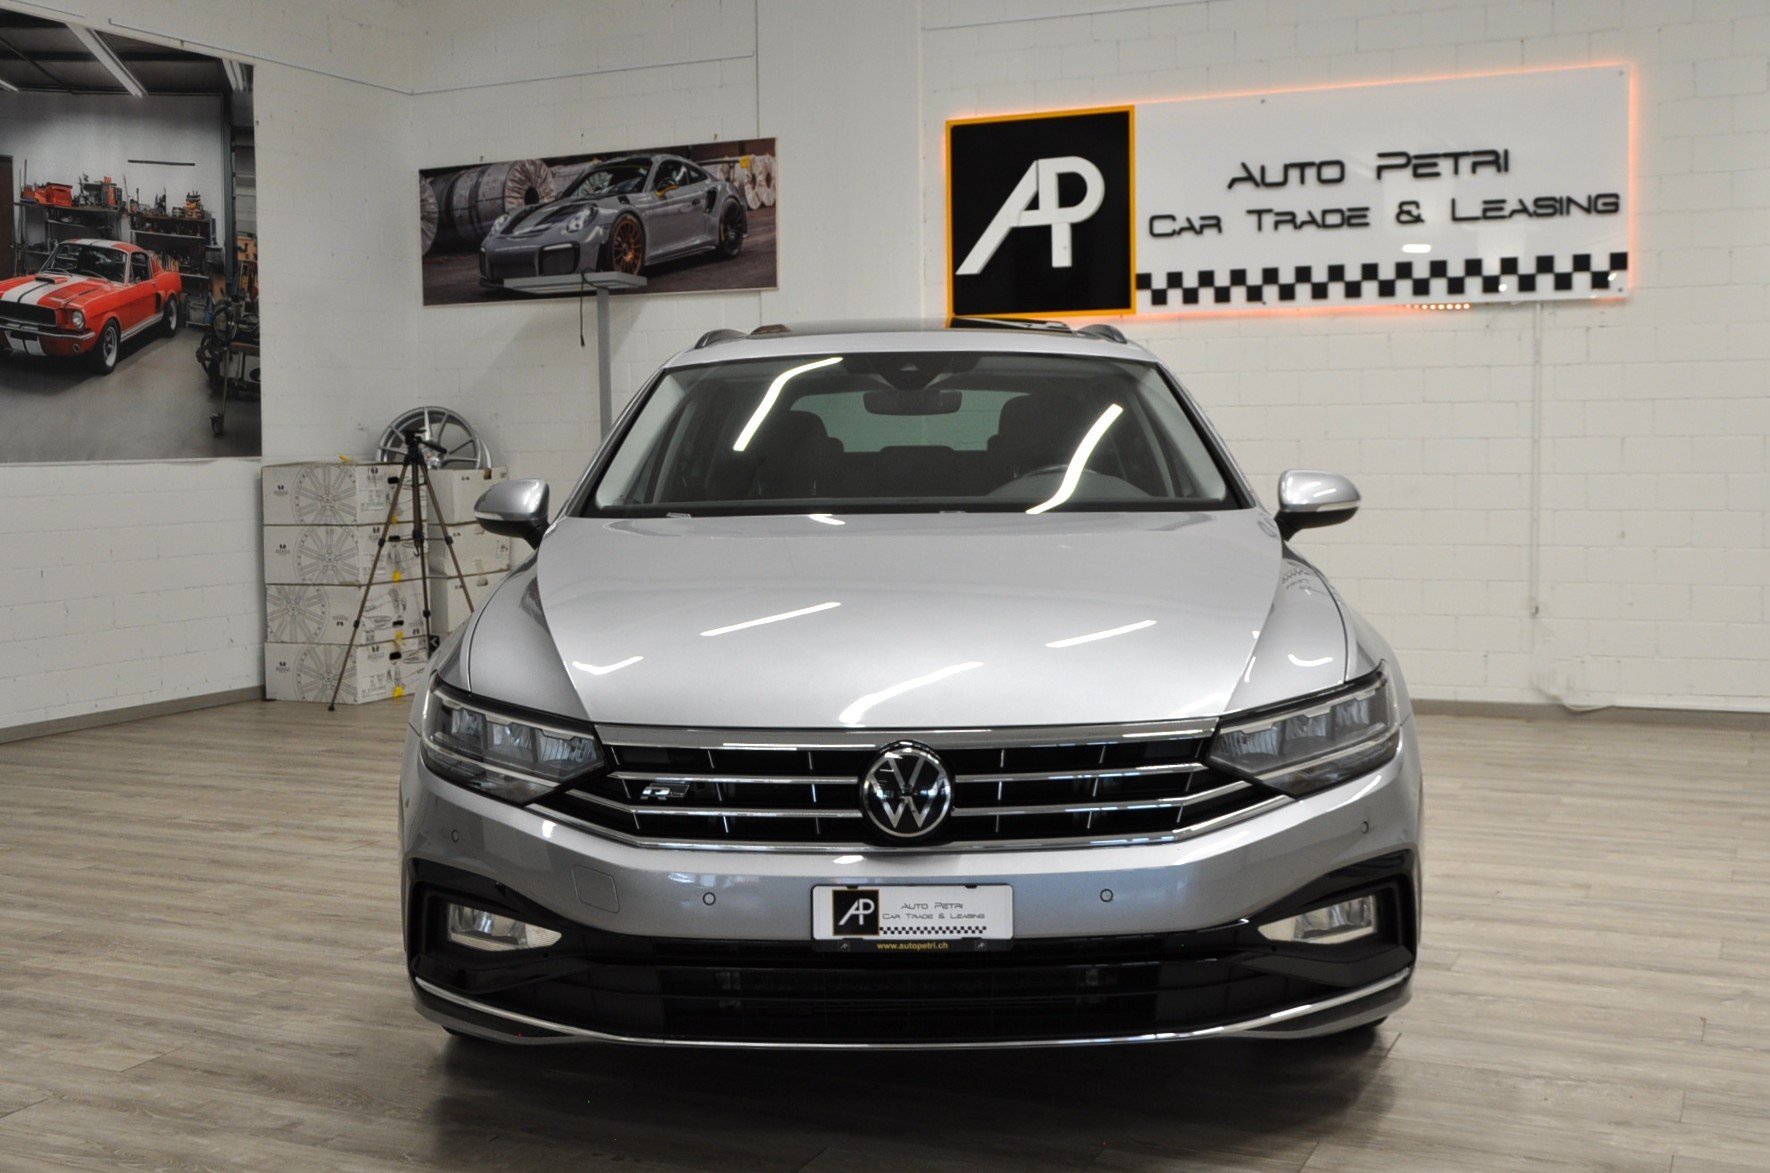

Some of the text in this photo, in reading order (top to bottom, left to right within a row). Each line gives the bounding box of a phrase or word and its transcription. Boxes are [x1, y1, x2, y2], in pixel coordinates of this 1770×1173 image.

[1227, 148, 1509, 189] AUTO PETRI
[1149, 193, 1620, 237] CAR TRADE & LEASING
[876, 942, 949, 950] www.autopetri.ch
